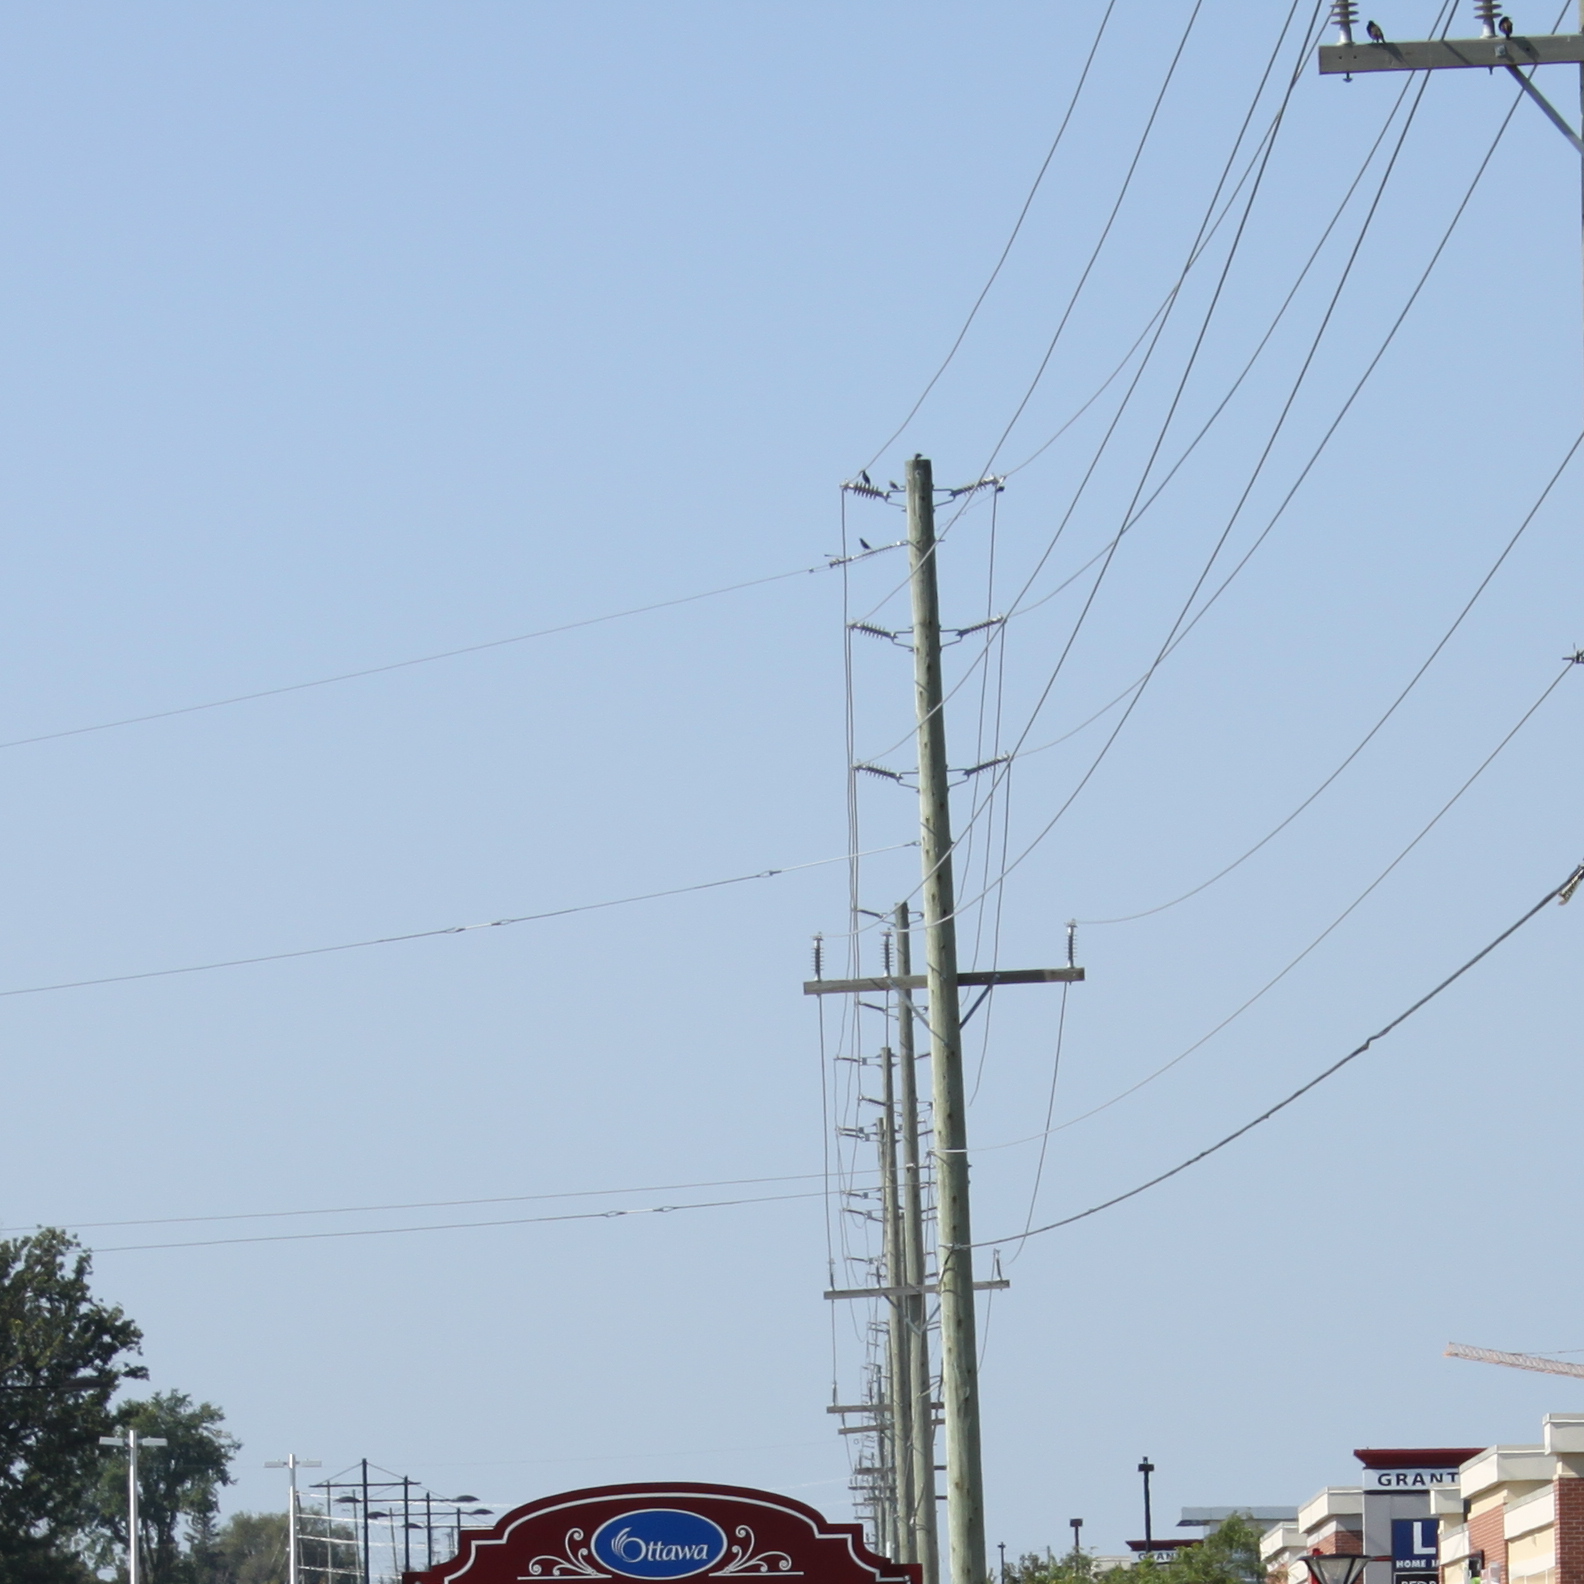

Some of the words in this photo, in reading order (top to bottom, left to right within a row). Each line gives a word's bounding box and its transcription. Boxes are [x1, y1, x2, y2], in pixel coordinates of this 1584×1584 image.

[1377, 1472, 1459, 1487] GRANT
[611, 1527, 708, 1563] Ottawa
[1396, 1560, 1426, 1568] HOME
